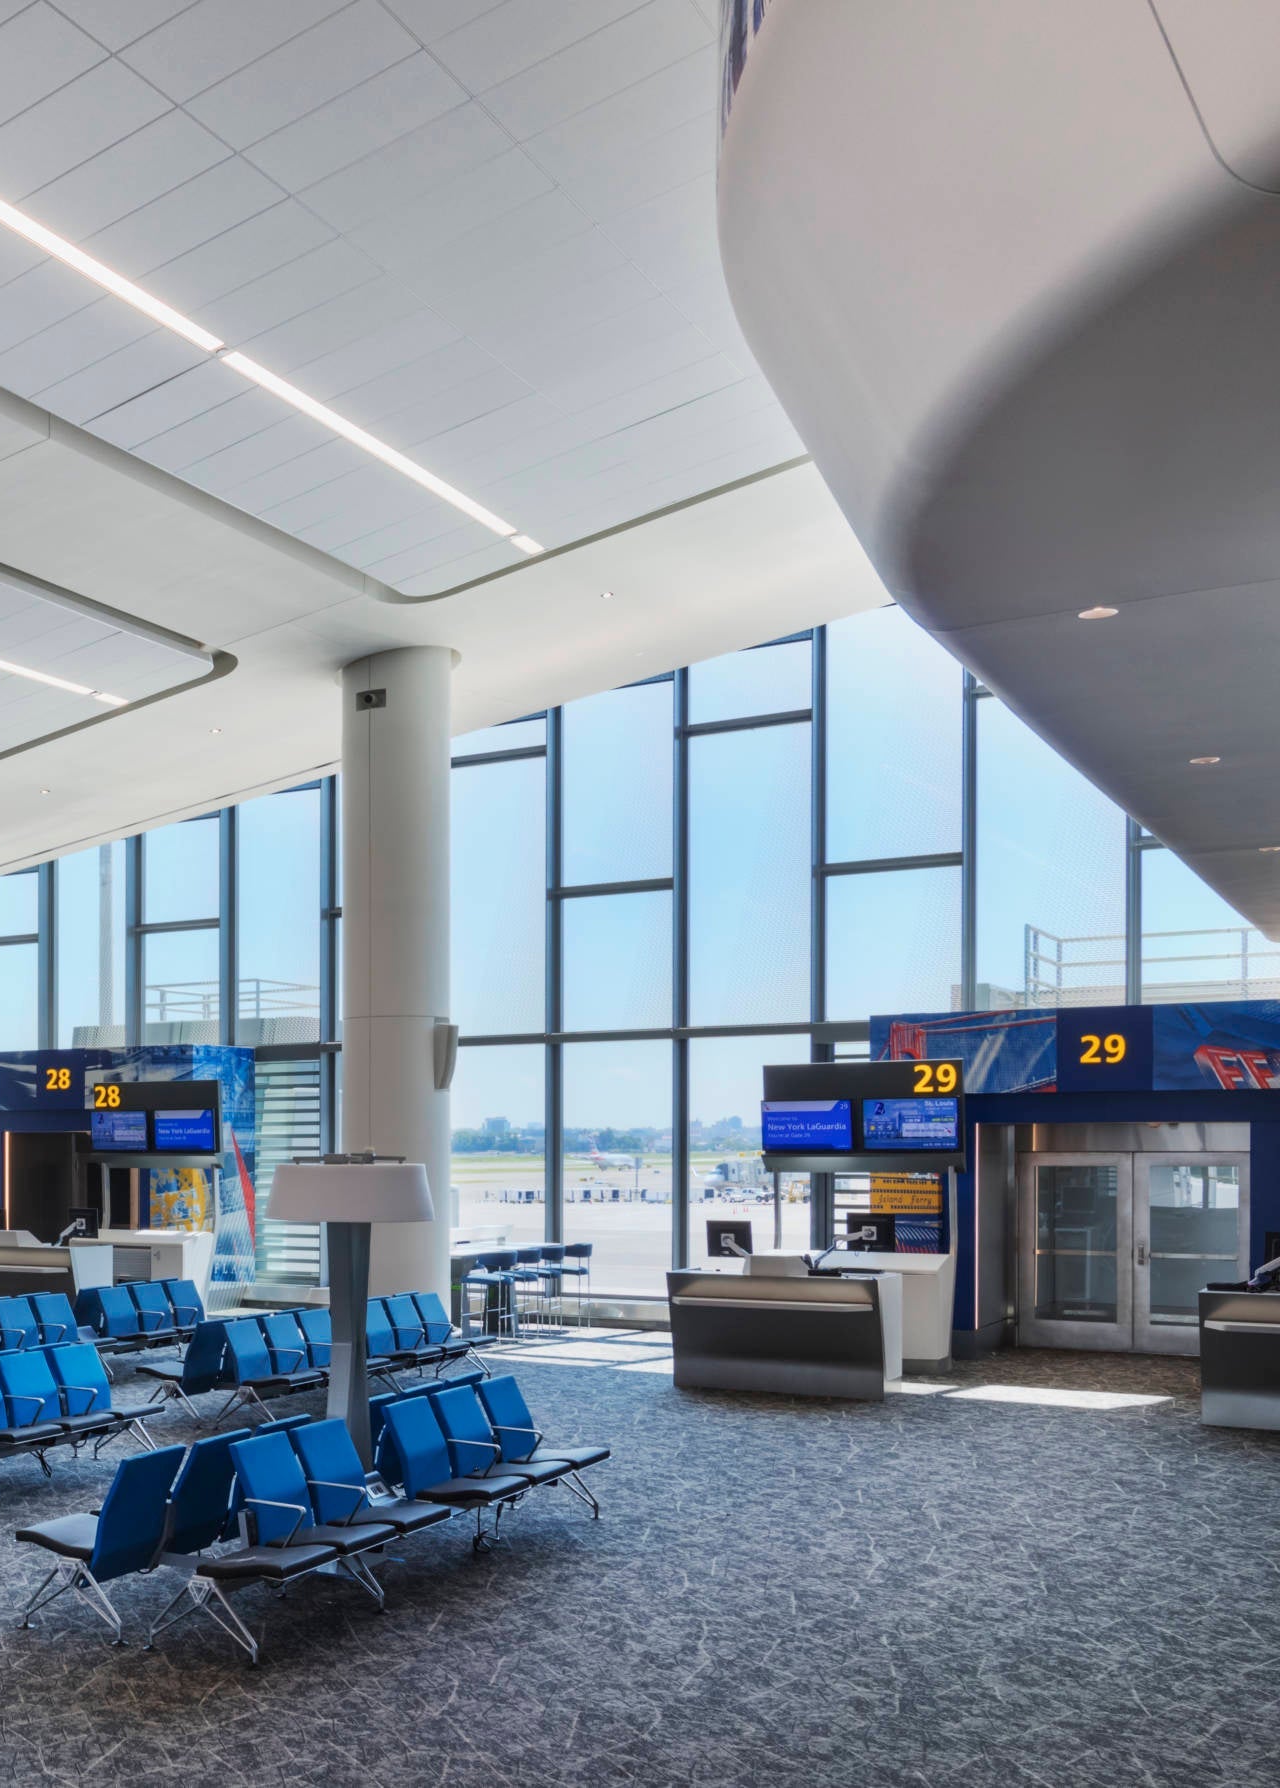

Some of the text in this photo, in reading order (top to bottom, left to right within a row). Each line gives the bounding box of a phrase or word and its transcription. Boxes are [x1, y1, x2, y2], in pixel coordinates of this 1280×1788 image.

[1079, 1033, 1127, 1064] 29
[46, 1068, 71, 1090] 28
[913, 1063, 957, 1093] 29
[94, 1085, 121, 1108] 28
[767, 1123, 786, 1131] New
[807, 1122, 847, 1130] LaGuardia
